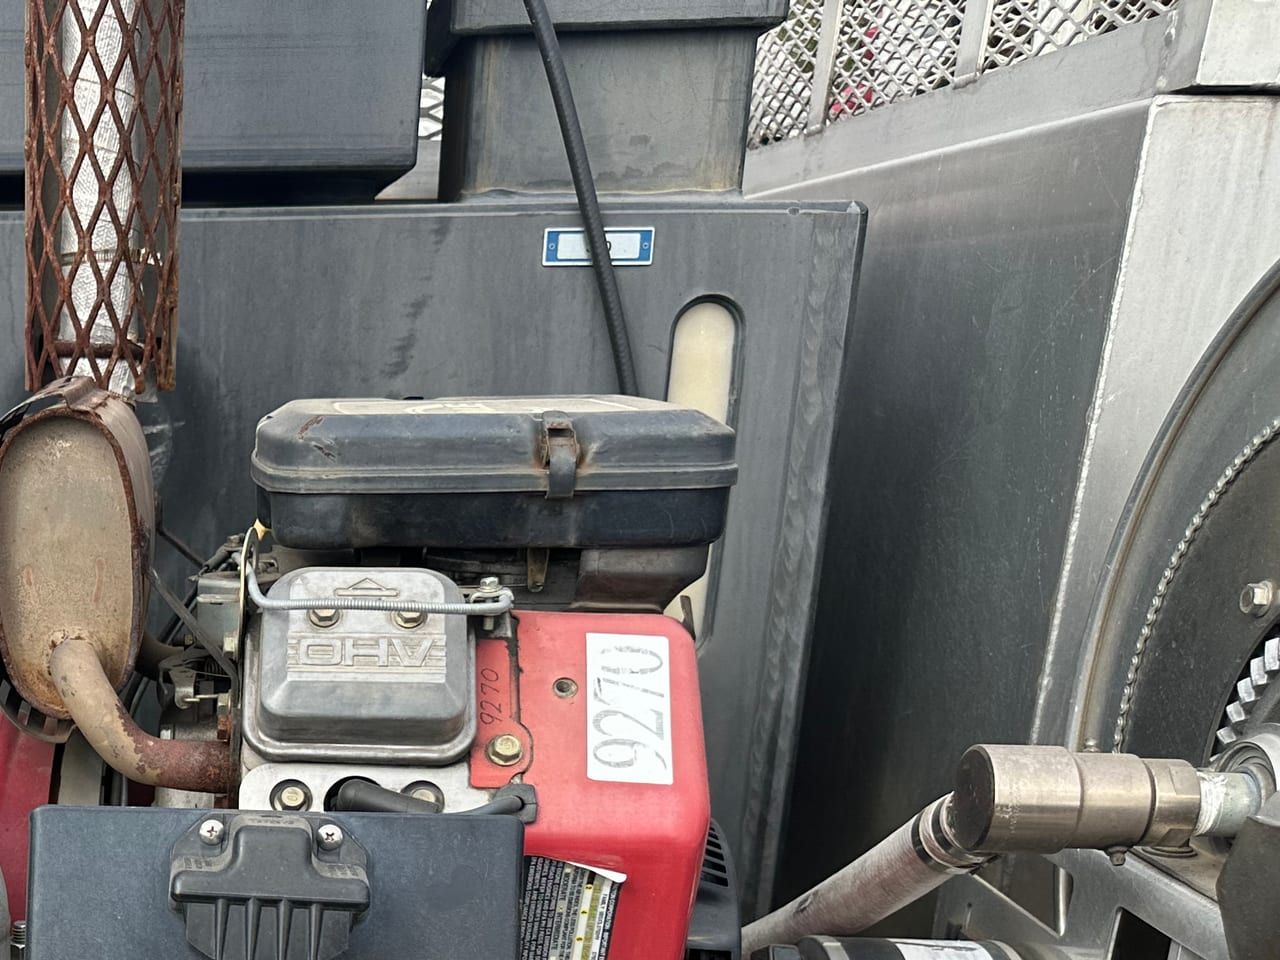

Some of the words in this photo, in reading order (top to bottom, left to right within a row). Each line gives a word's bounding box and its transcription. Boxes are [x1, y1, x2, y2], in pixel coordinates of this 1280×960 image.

[299, 637, 434, 668] OHV
[480, 667, 501, 727] 9270
[592, 644, 670, 773] 9270
